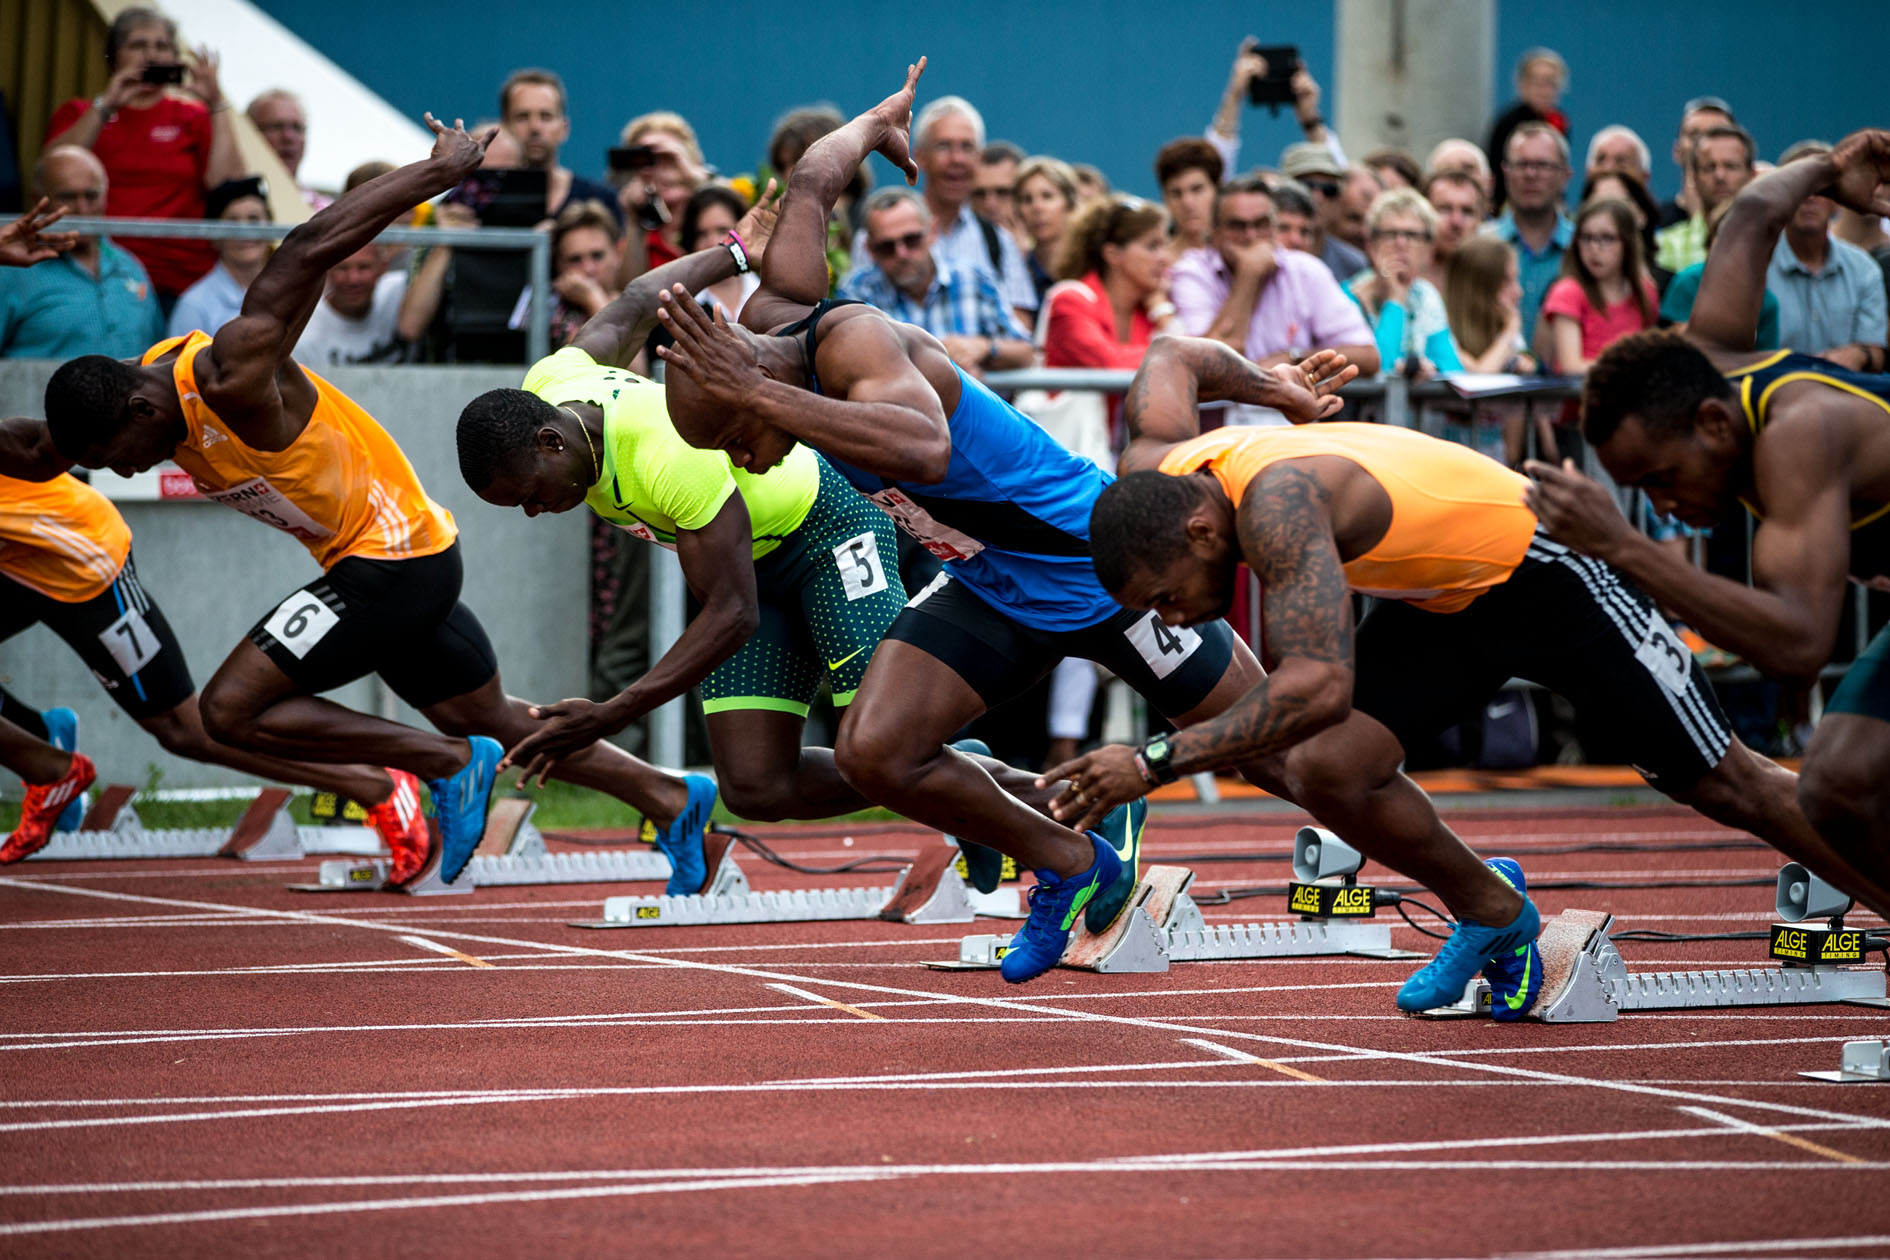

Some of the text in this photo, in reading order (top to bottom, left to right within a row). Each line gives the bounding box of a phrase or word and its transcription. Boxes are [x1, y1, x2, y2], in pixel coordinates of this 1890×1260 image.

[849, 541, 874, 588] 5
[282, 603, 321, 639] 6
[1150, 614, 1185, 656] 4
[116, 621, 144, 660] 7
[1651, 632, 1685, 674] 3
[1292, 886, 1320, 905] ALGE
[1333, 888, 1371, 906] ALGE
[1774, 930, 1807, 951] ALGE
[1775, 948, 1805, 957] TIMING
[1821, 933, 1860, 951] ALGE
